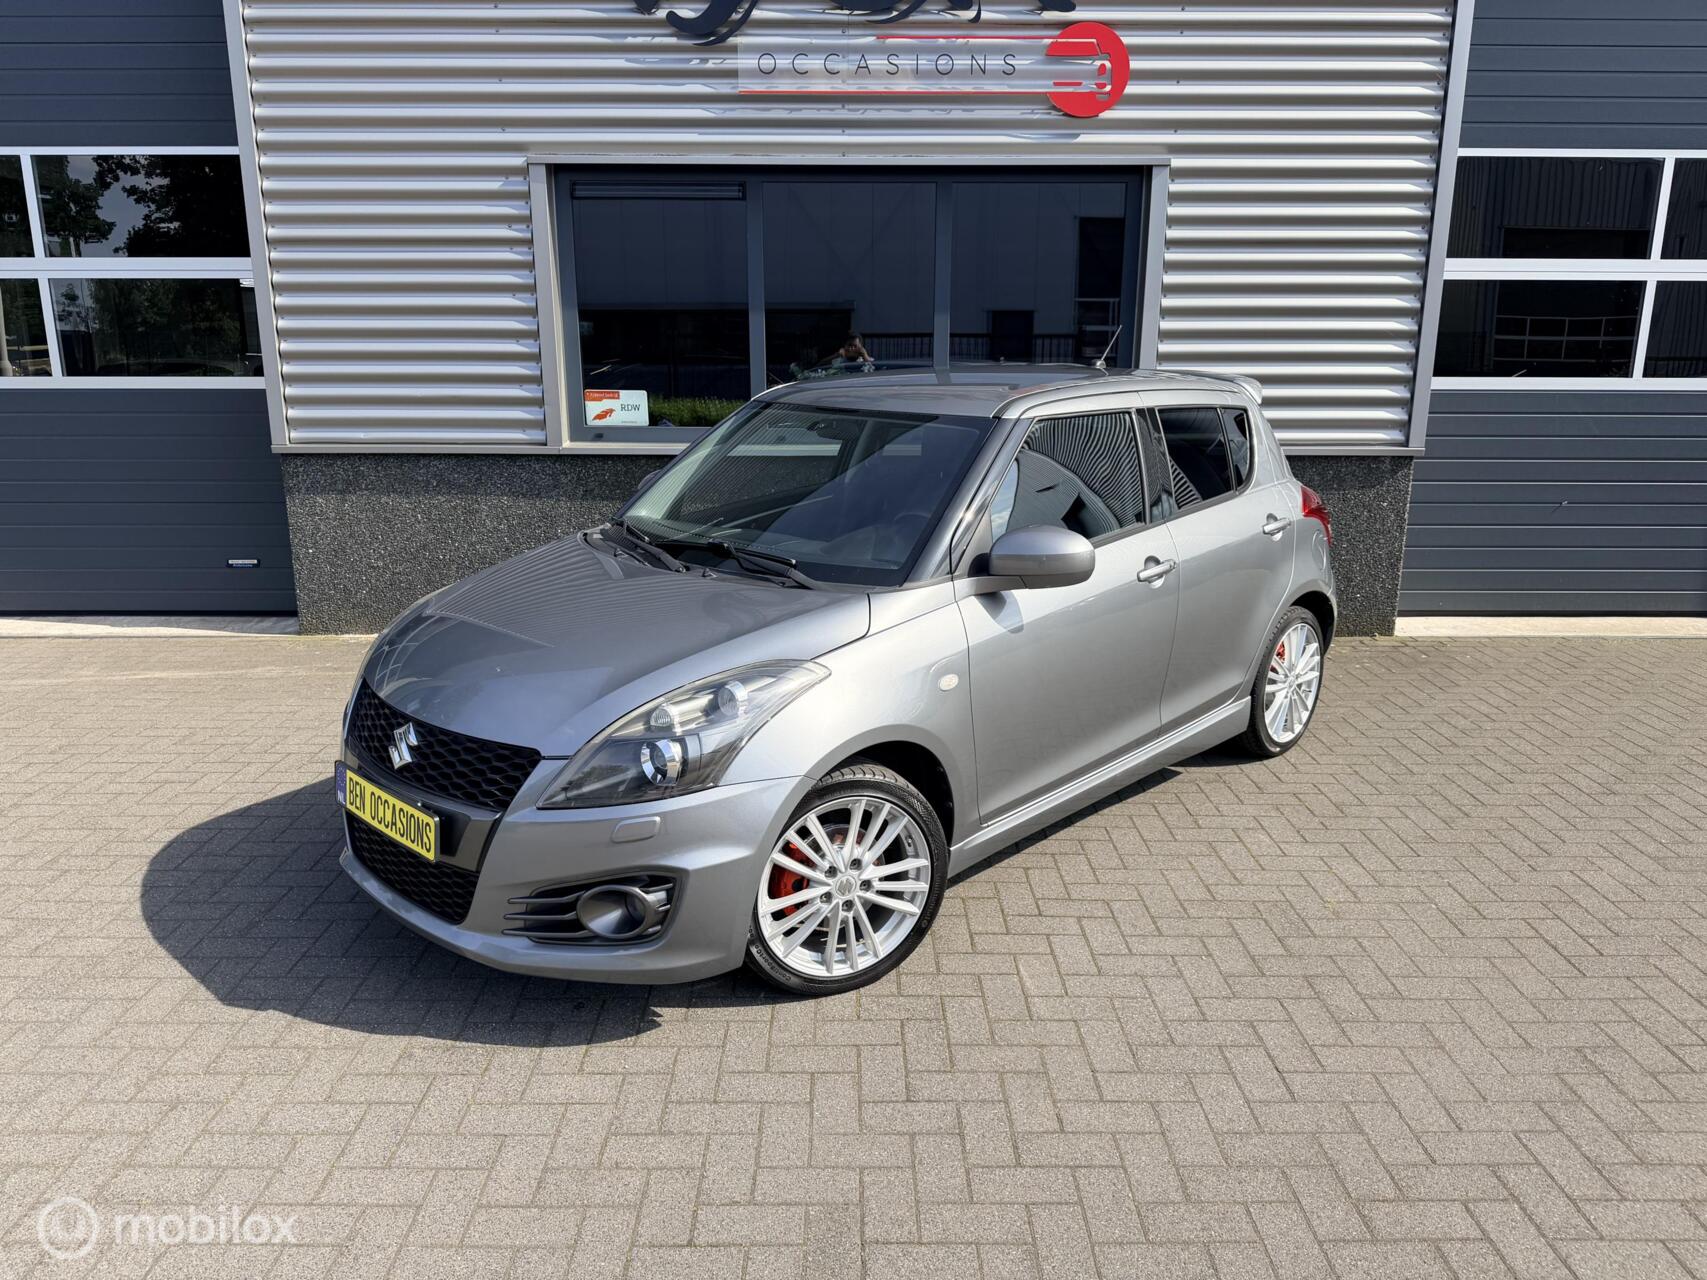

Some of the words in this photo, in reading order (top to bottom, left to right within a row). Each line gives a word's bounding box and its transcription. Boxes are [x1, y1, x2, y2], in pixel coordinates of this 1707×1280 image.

[757, 52, 1017, 76] OCCASIONS
[620, 403, 641, 412] RDW
[337, 789, 346, 805] NL
[348, 776, 366, 815] BEN
[369, 791, 432, 854] OCCASIONS
